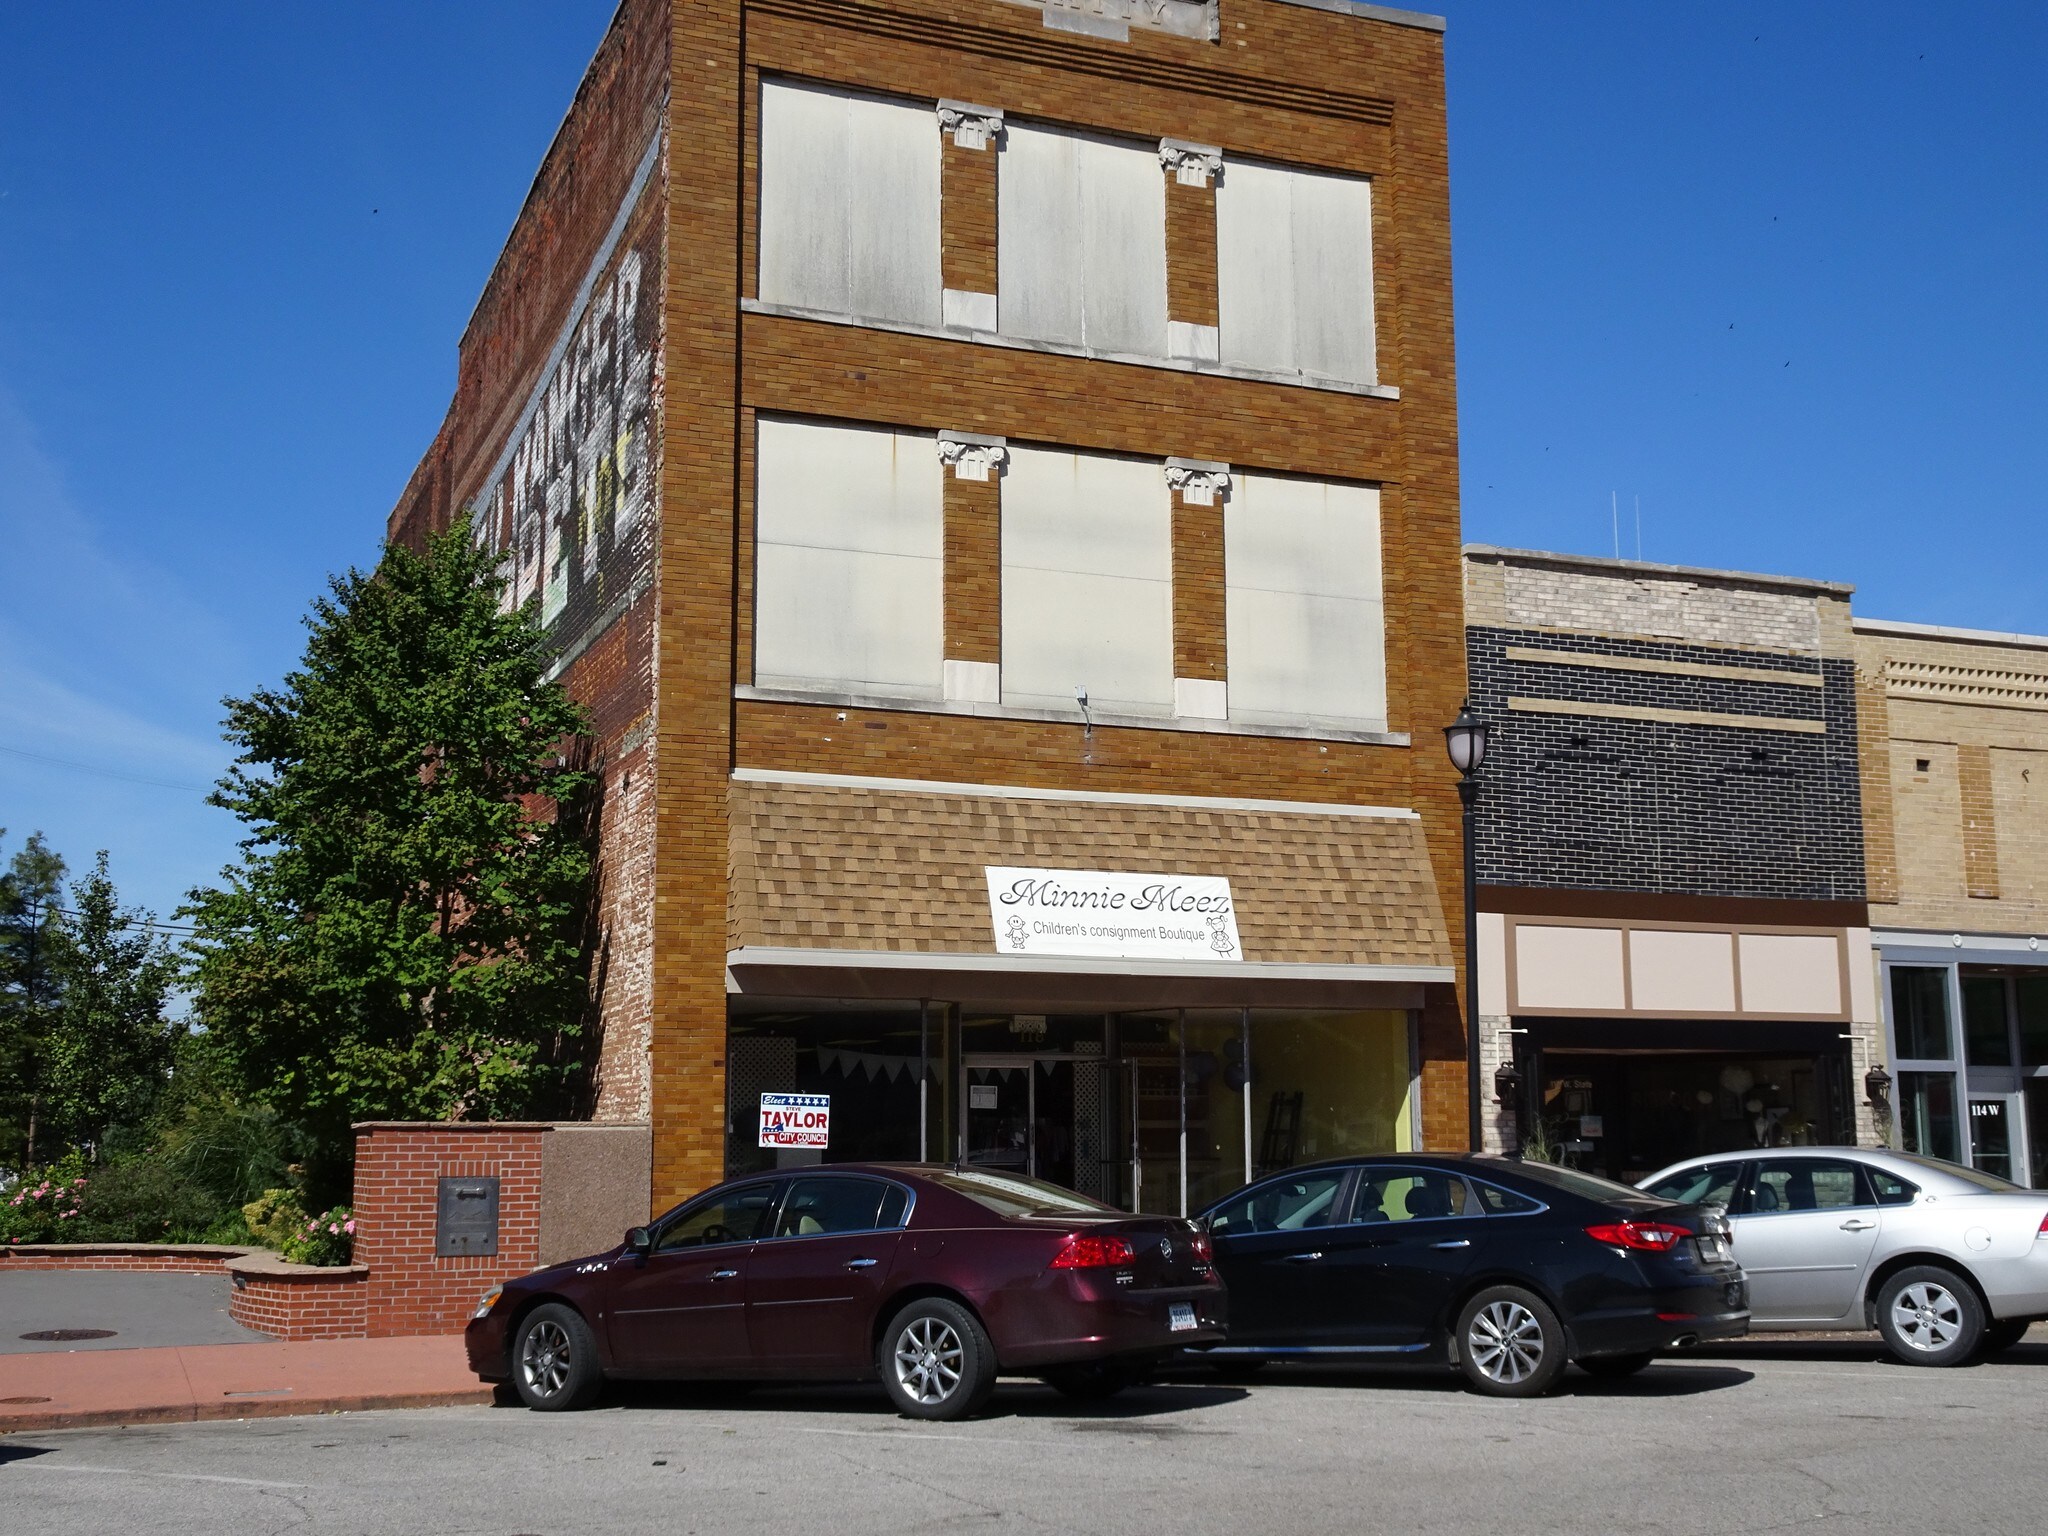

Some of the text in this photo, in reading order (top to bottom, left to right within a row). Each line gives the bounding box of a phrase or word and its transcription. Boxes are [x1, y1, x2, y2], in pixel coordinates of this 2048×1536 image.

[999, 879, 1229, 914] Minnie Meez
[1033, 920, 1205, 943] Children's consignment Boutique
[763, 1095, 786, 1104] Elect
[1971, 1104, 2000, 1116] 114 W
[762, 1111, 827, 1128] TAYLOR
[779, 1132, 796, 1141] CITY
[796, 1133, 827, 1143] COUNCIL
